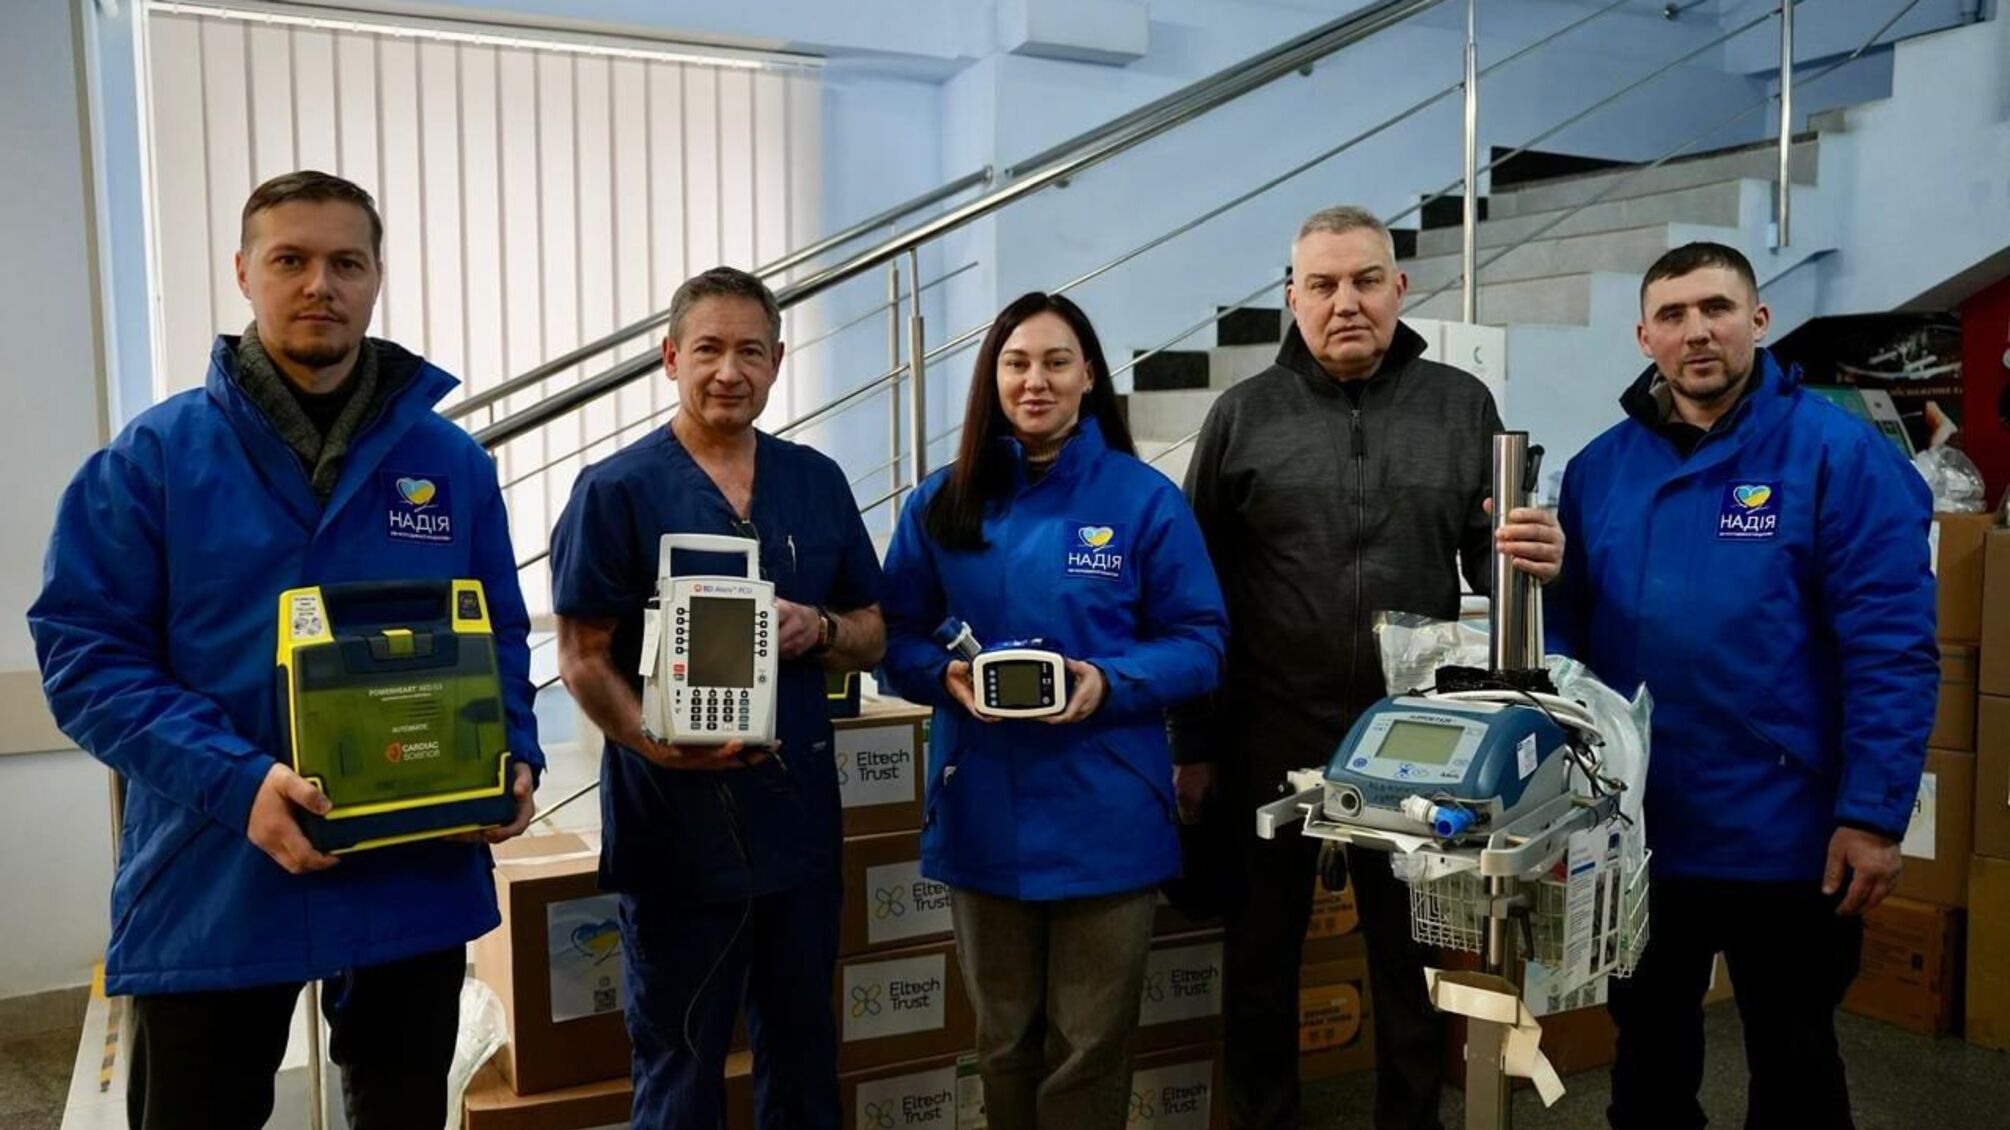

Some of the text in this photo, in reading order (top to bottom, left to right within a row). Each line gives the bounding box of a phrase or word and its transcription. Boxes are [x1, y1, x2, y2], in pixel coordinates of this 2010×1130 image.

[389, 510, 450, 534] НАДІЯ
[1720, 514, 1776, 532] НАДІЯ
[1068, 552, 1122, 570] НАДІЯ
[402, 741, 439, 752] CARDIAC
[856, 749, 910, 767] Eltech
[857, 765, 900, 781] Trust
[1171, 964, 1218, 983] Eltech
[889, 977, 941, 997] Eltech
[1171, 982, 1208, 997] Trust
[890, 994, 931, 1010] Trust
[902, 1088, 953, 1111] Eltech
[1162, 1081, 1207, 1102] Eltech
[903, 1107, 943, 1124] Trust
[1162, 1100, 1198, 1115] Trust
